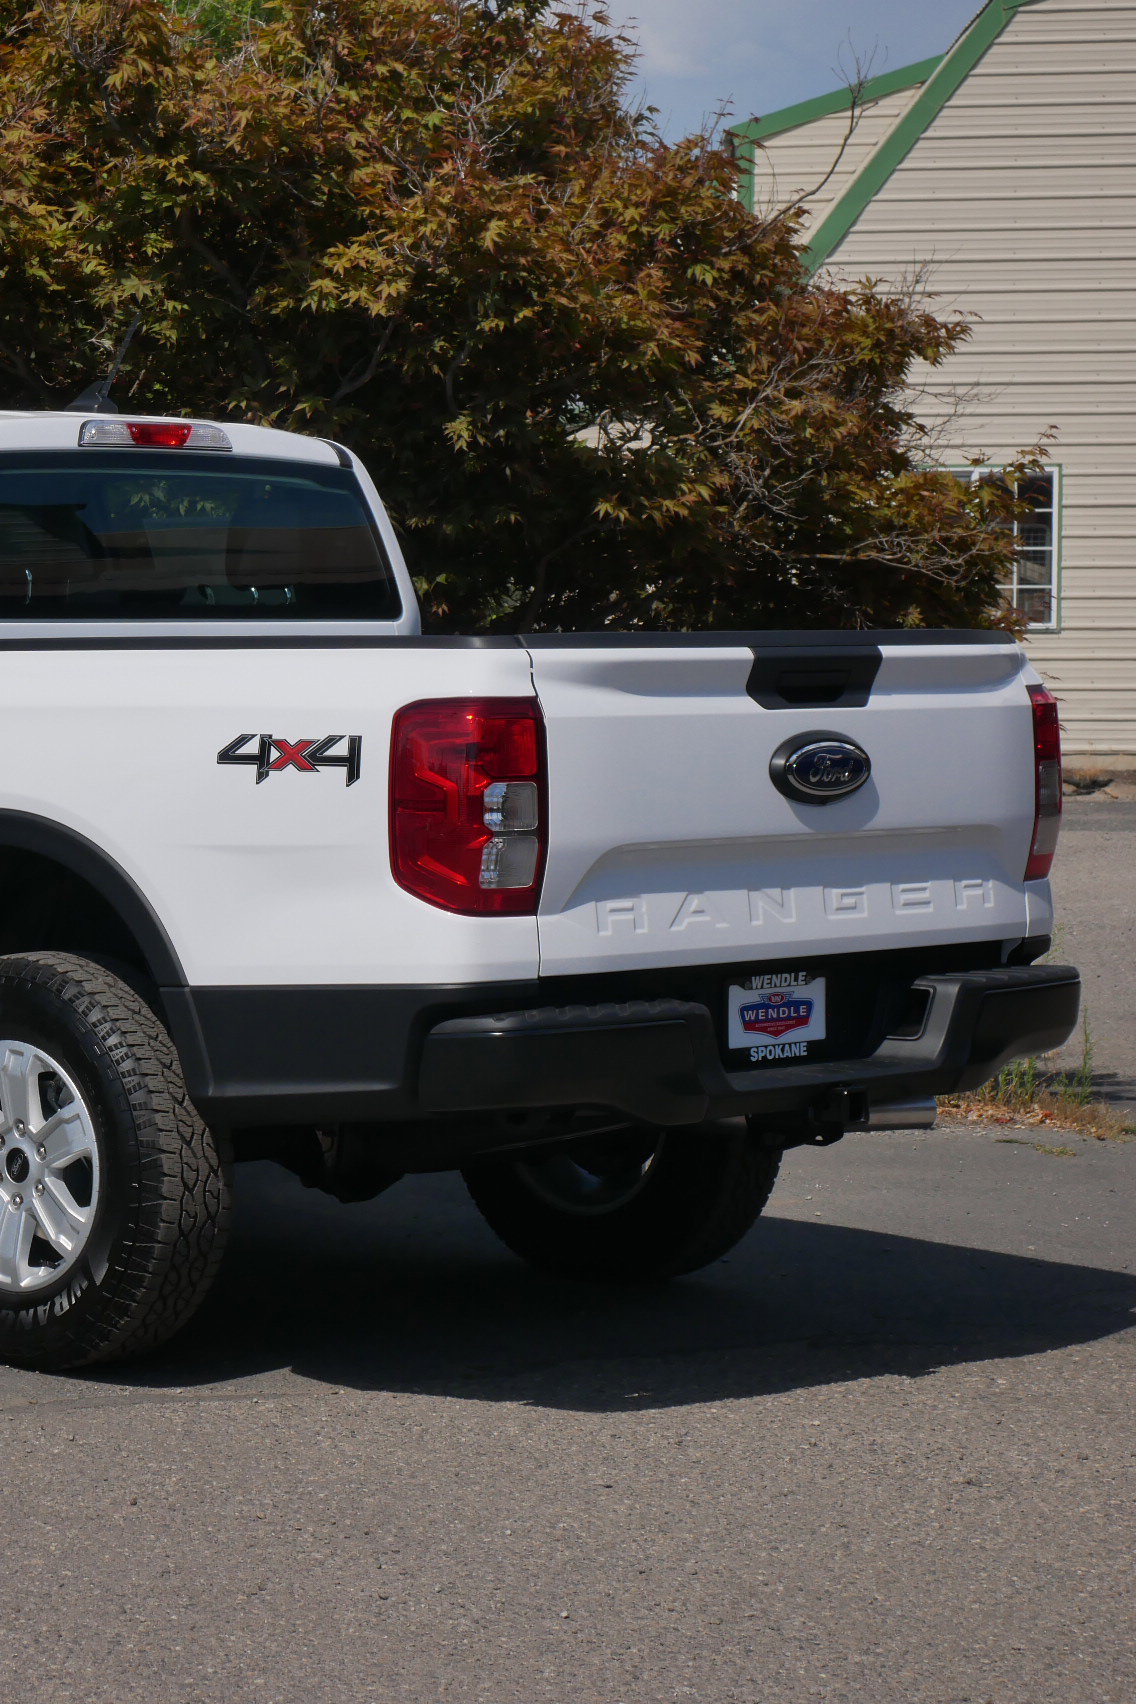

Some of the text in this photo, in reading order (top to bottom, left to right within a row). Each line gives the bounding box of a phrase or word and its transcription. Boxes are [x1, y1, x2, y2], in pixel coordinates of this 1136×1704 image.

[809, 753, 854, 783] Ford
[595, 879, 995, 936] RANGER
[751, 971, 807, 990] WENDLE
[744, 1005, 807, 1021] WENDLE
[750, 1042, 808, 1062] SPOKANE
